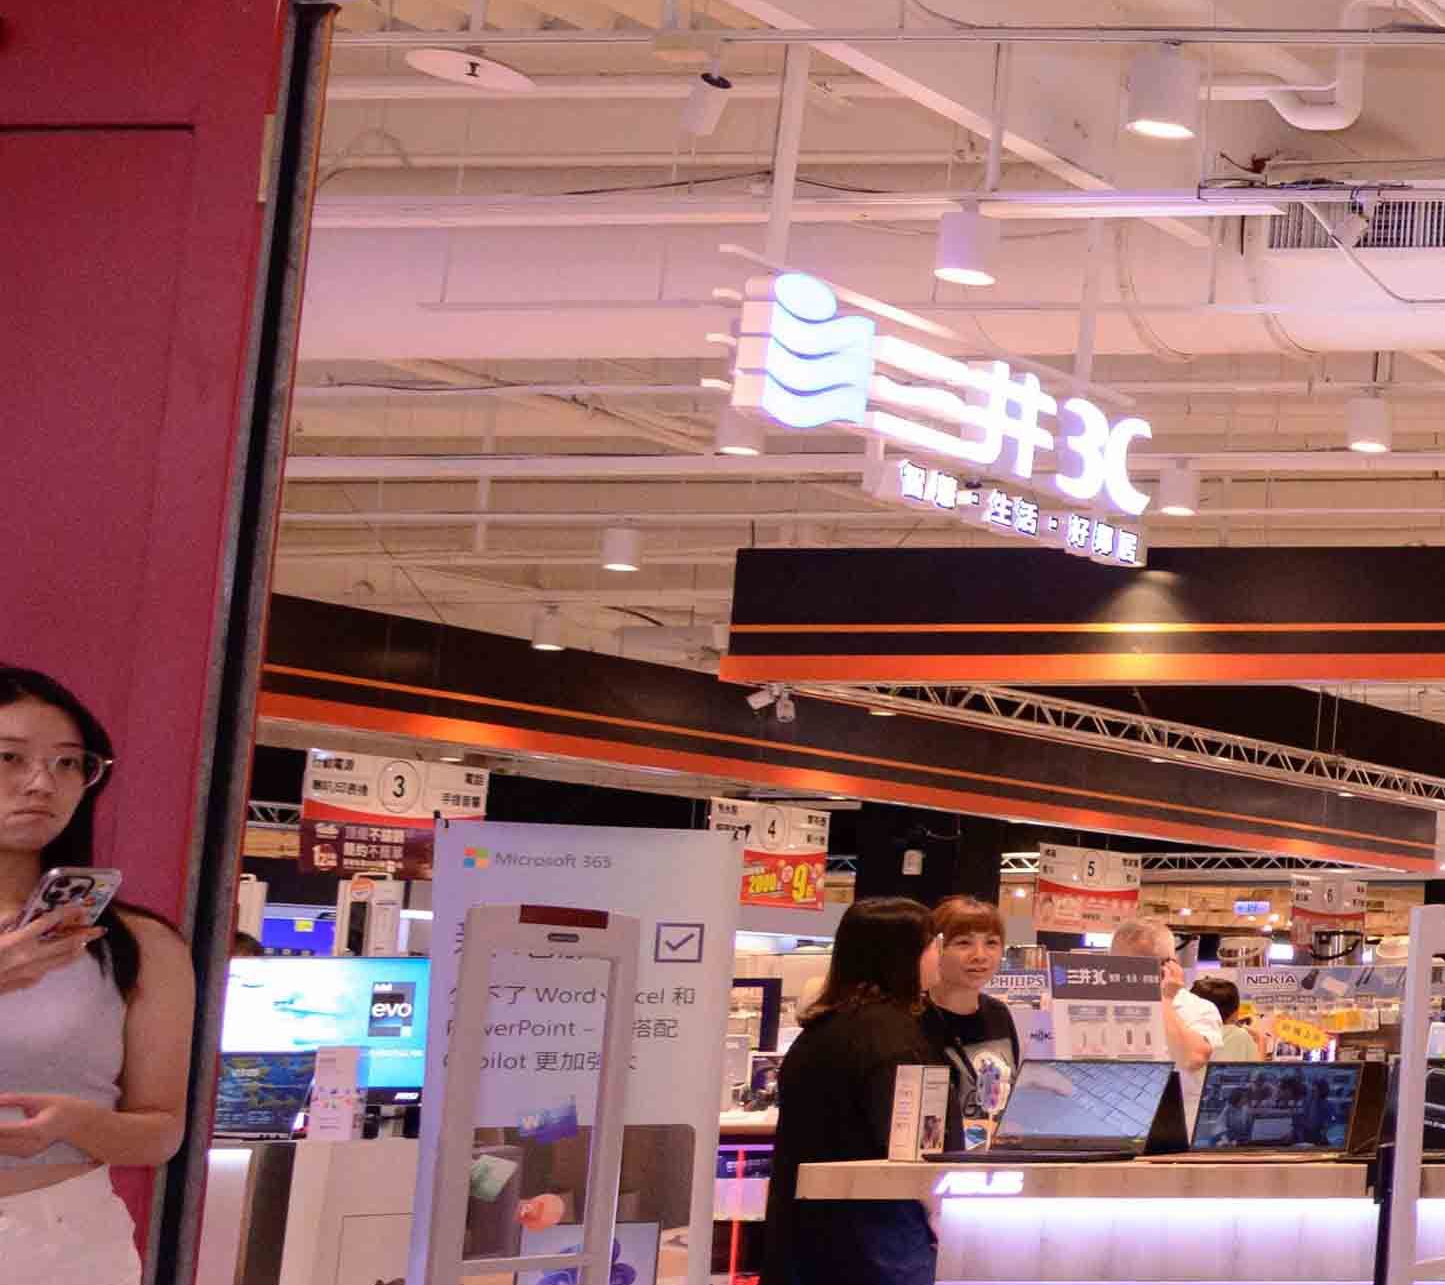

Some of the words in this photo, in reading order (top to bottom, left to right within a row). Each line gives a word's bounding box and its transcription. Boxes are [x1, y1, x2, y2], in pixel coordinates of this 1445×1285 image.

[392, 774, 405, 798] 3
[767, 819, 776, 838] 4
[495, 851, 577, 869] Microsoft
[583, 854, 612, 869] 365
[1087, 860, 1096, 877] 5
[1246, 974, 1297, 985] NOKIA
[671, 986, 696, 1006] 和
[371, 1002, 413, 1018] evo
